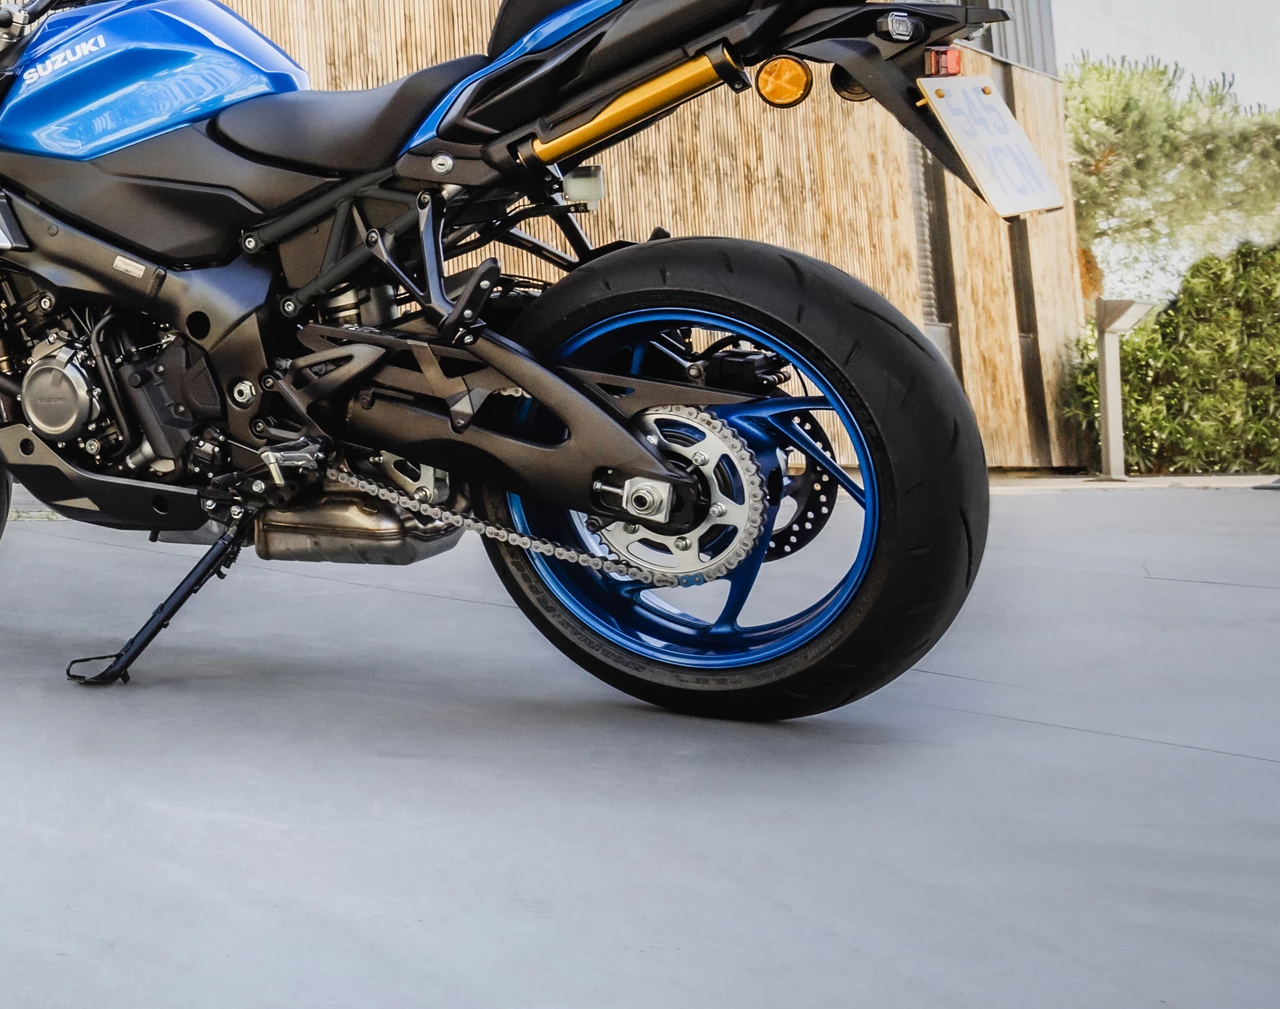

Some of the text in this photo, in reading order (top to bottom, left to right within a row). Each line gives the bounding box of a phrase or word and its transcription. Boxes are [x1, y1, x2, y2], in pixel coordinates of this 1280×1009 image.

[22, 34, 107, 85] SUZUKI
[943, 86, 1010, 138] 545
[974, 142, 1046, 198] YCN
